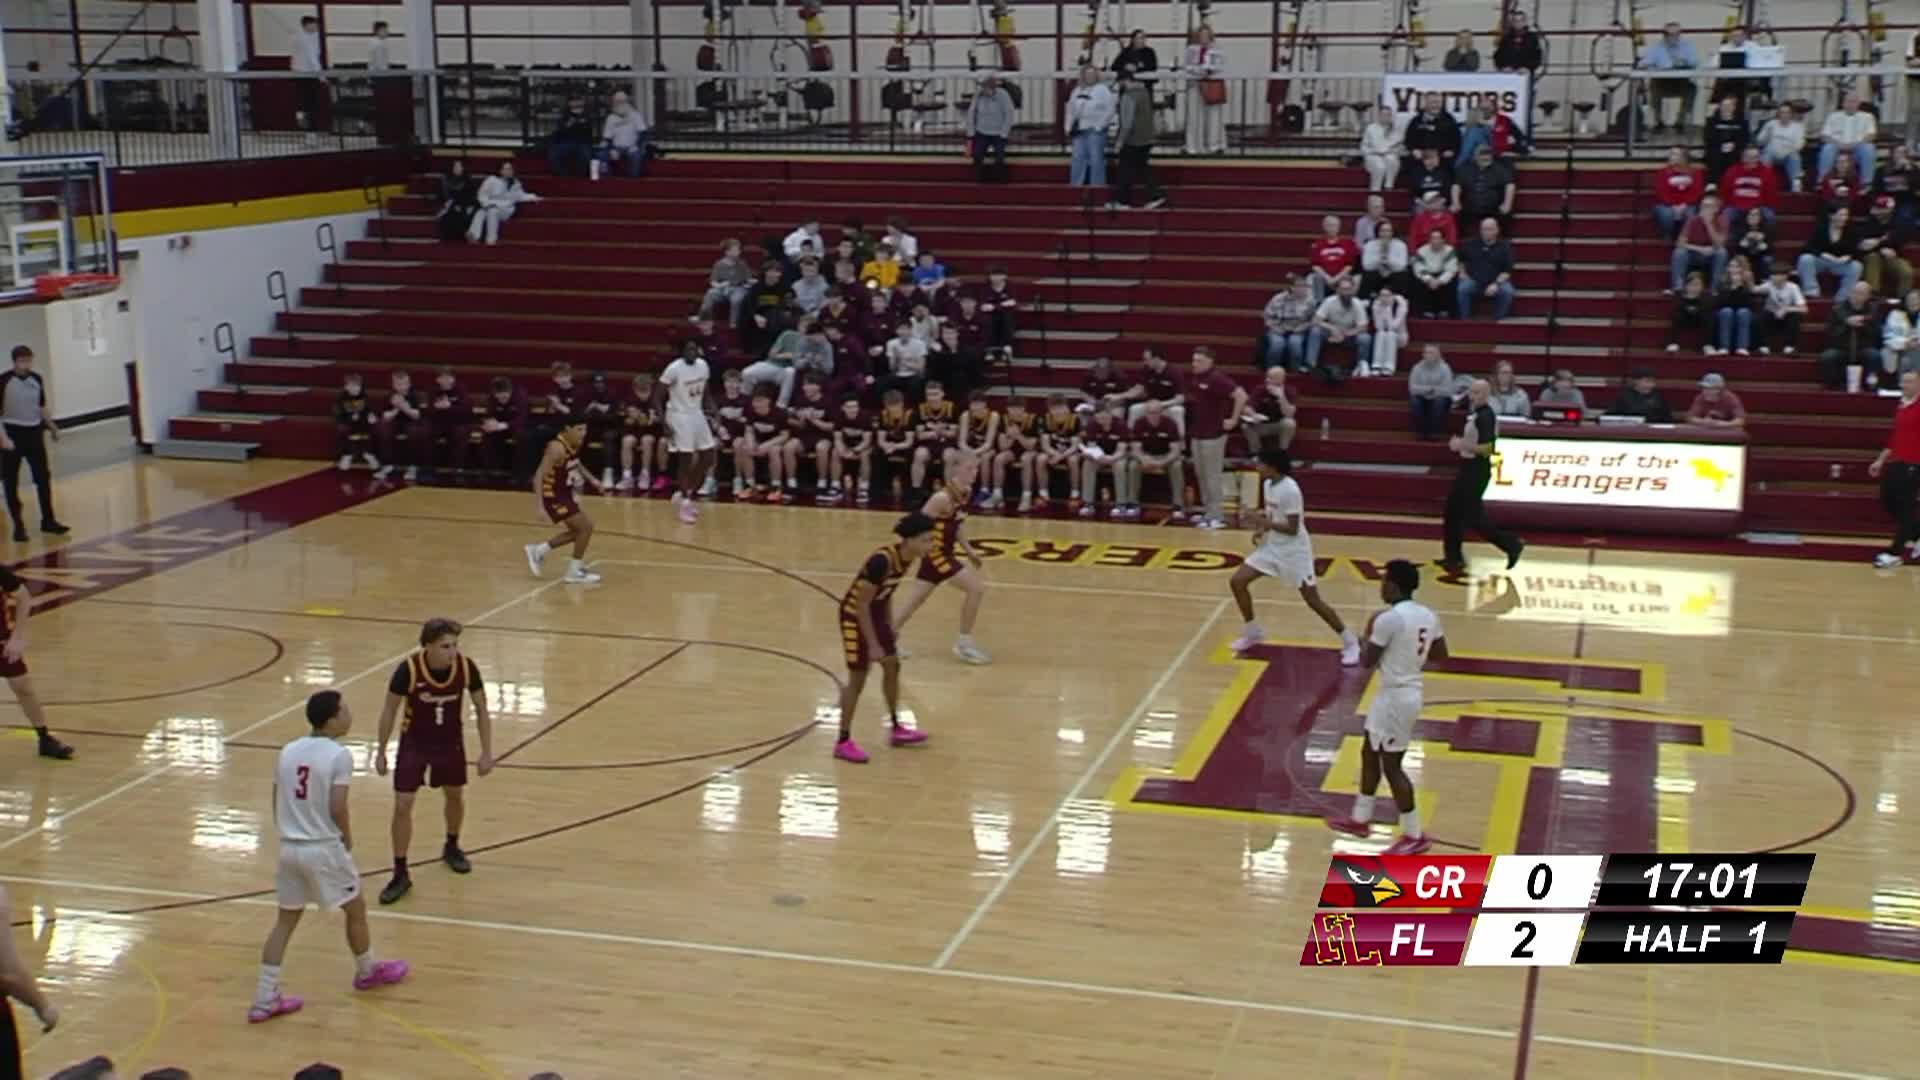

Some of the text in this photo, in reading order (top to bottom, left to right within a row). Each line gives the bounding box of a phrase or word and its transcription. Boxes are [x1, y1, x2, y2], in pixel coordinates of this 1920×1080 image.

[1392, 87, 1518, 113] VIITORS
[1521, 450, 1679, 469] Home of the
[1529, 468, 1669, 494] Rangers
[1417, 626, 1428, 657] 5
[435, 706, 444, 726] 1
[295, 765, 310, 801] 3
